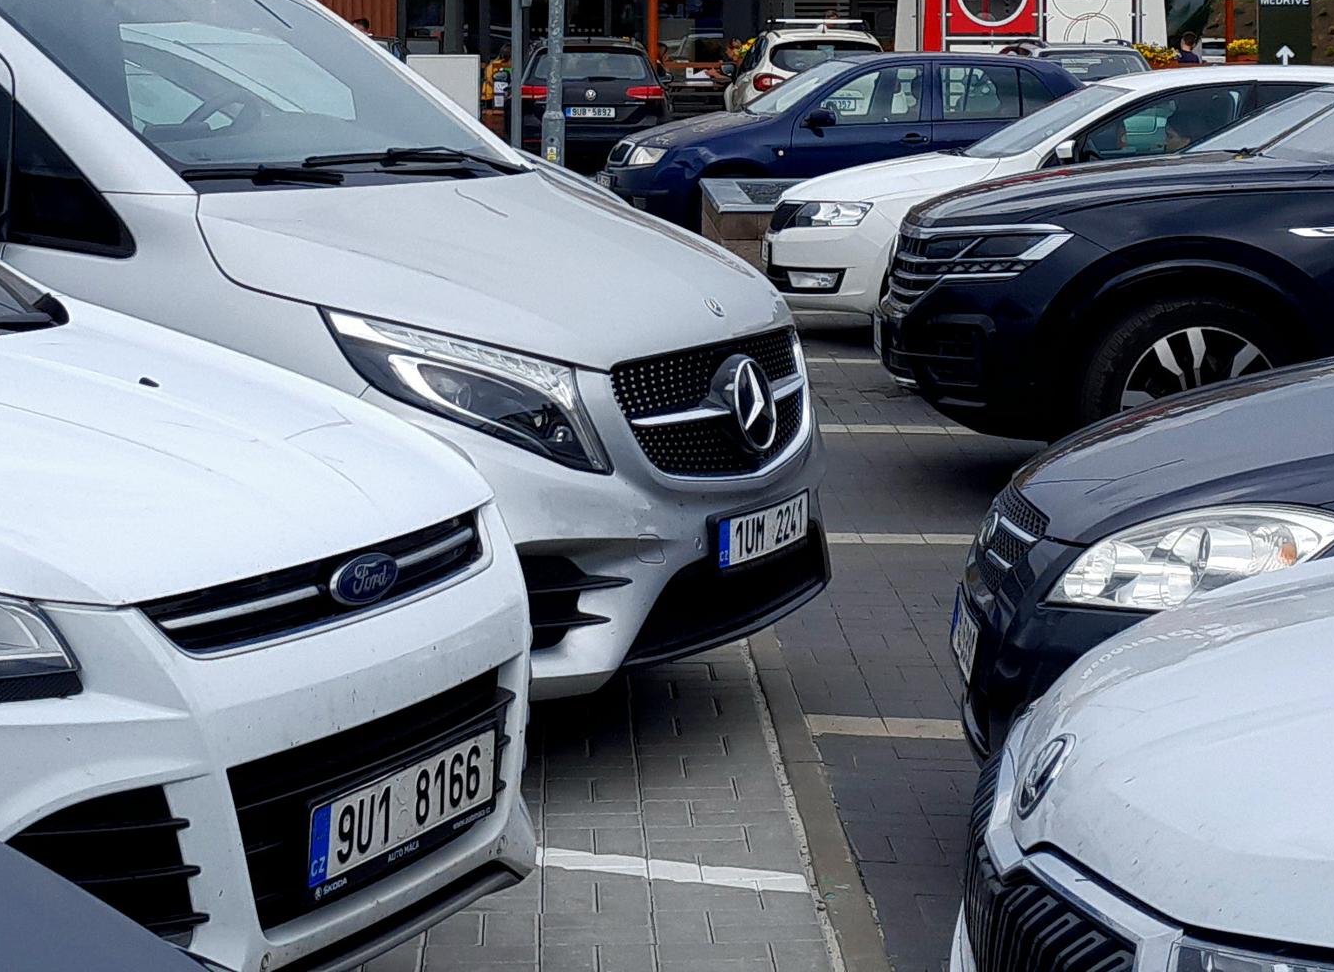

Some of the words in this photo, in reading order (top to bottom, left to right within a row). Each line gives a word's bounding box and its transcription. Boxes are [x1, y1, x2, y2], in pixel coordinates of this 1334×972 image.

[736, 515, 765, 557] 1UM
[775, 498, 803, 545] 2241
[352, 562, 388, 594] Ford
[337, 785, 391, 864] 9U1
[415, 745, 481, 825] 8166
[310, 856, 326, 877] CZ
